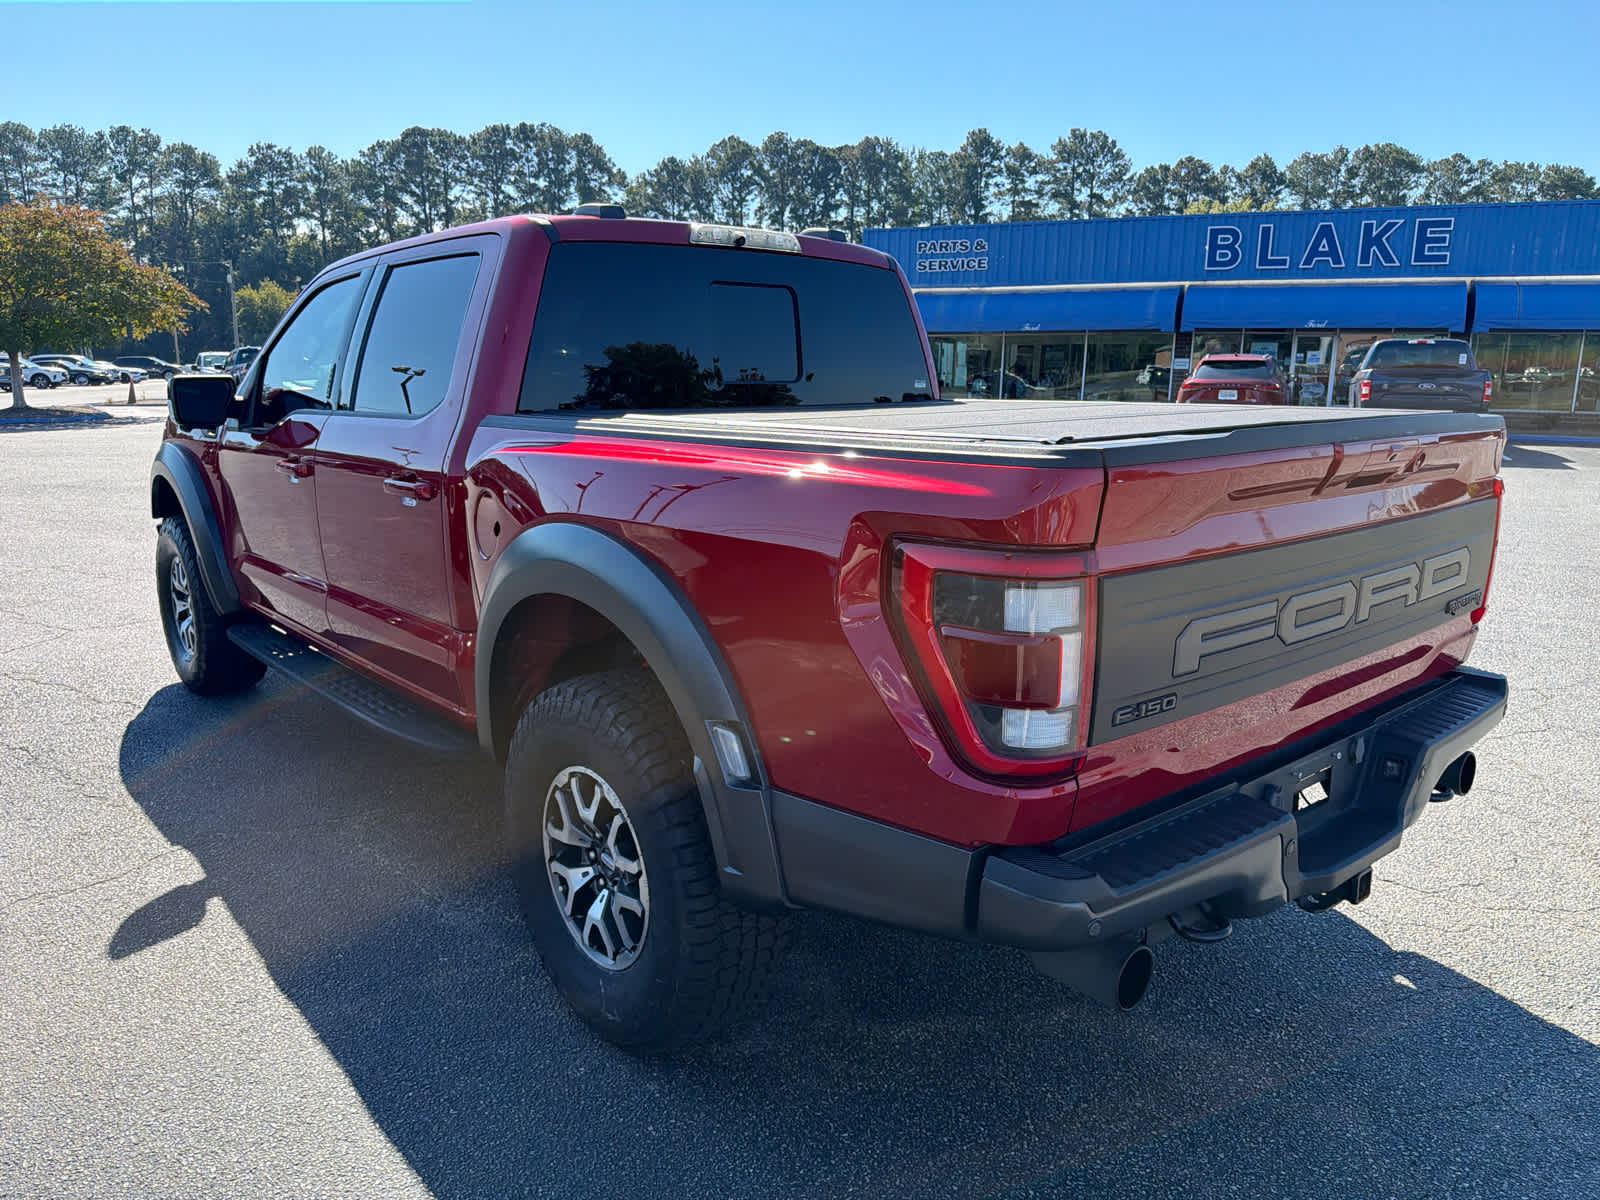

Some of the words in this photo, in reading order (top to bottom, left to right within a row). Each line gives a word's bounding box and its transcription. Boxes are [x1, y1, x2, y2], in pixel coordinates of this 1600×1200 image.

[917, 240, 970, 254] PARTS
[973, 238, 988, 252] &
[1204, 217, 1455, 271] BLAKE
[917, 257, 989, 272] SERVICE
[1304, 319, 1329, 329] Ford
[1172, 545, 1472, 678] FORD
[1112, 693, 1178, 727] F-150
